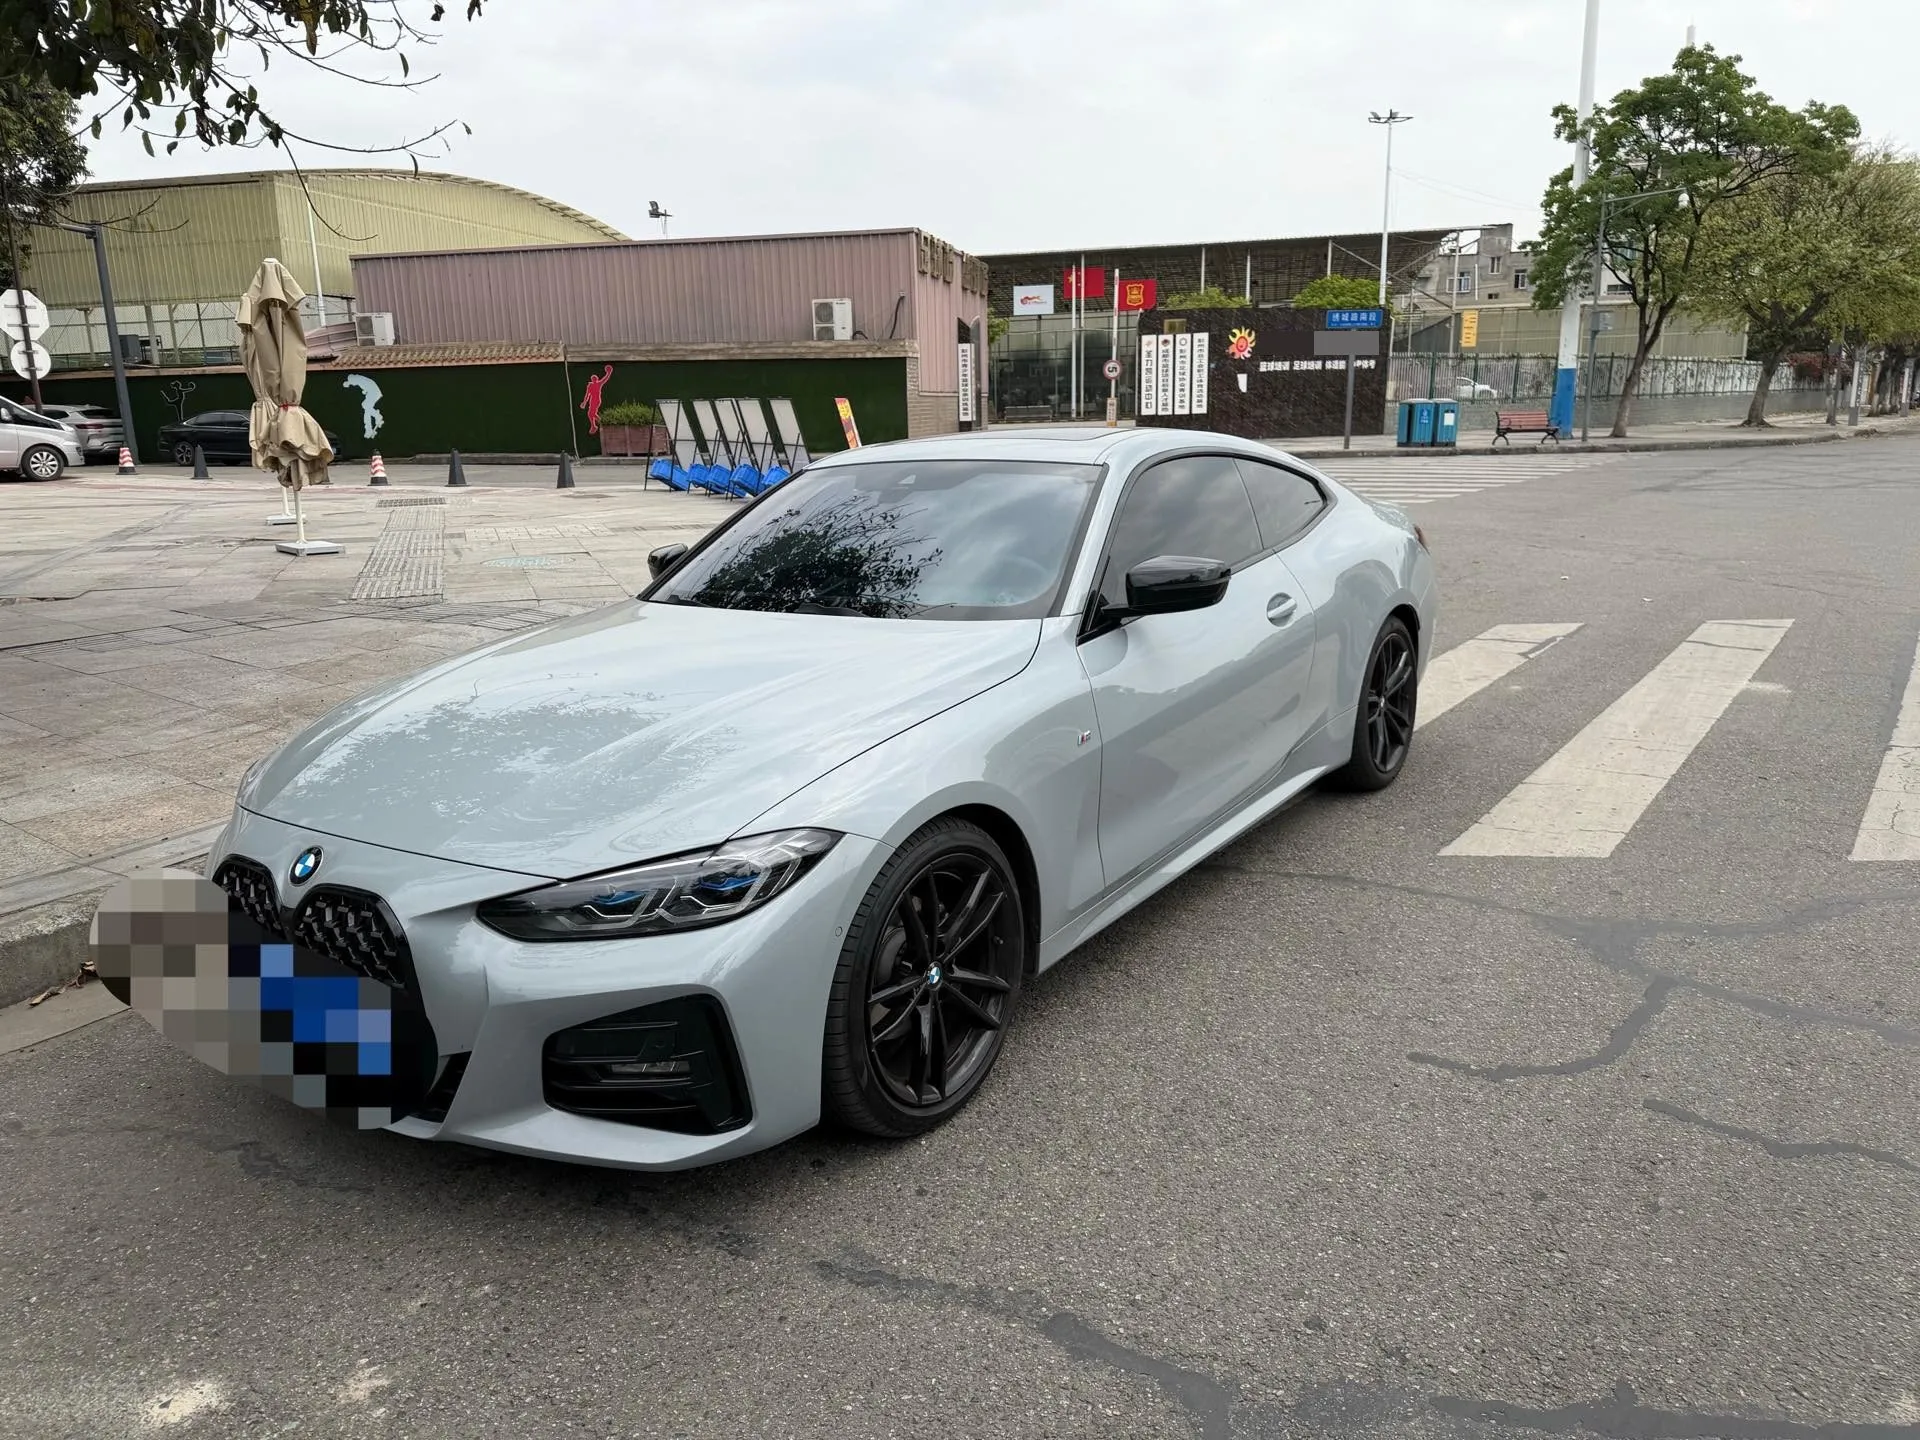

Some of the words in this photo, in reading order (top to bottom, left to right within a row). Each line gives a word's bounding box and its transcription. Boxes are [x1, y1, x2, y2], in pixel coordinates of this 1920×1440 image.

[1259, 360, 1290, 372] 篮球培训
[1292, 360, 1322, 371] 足球培训
